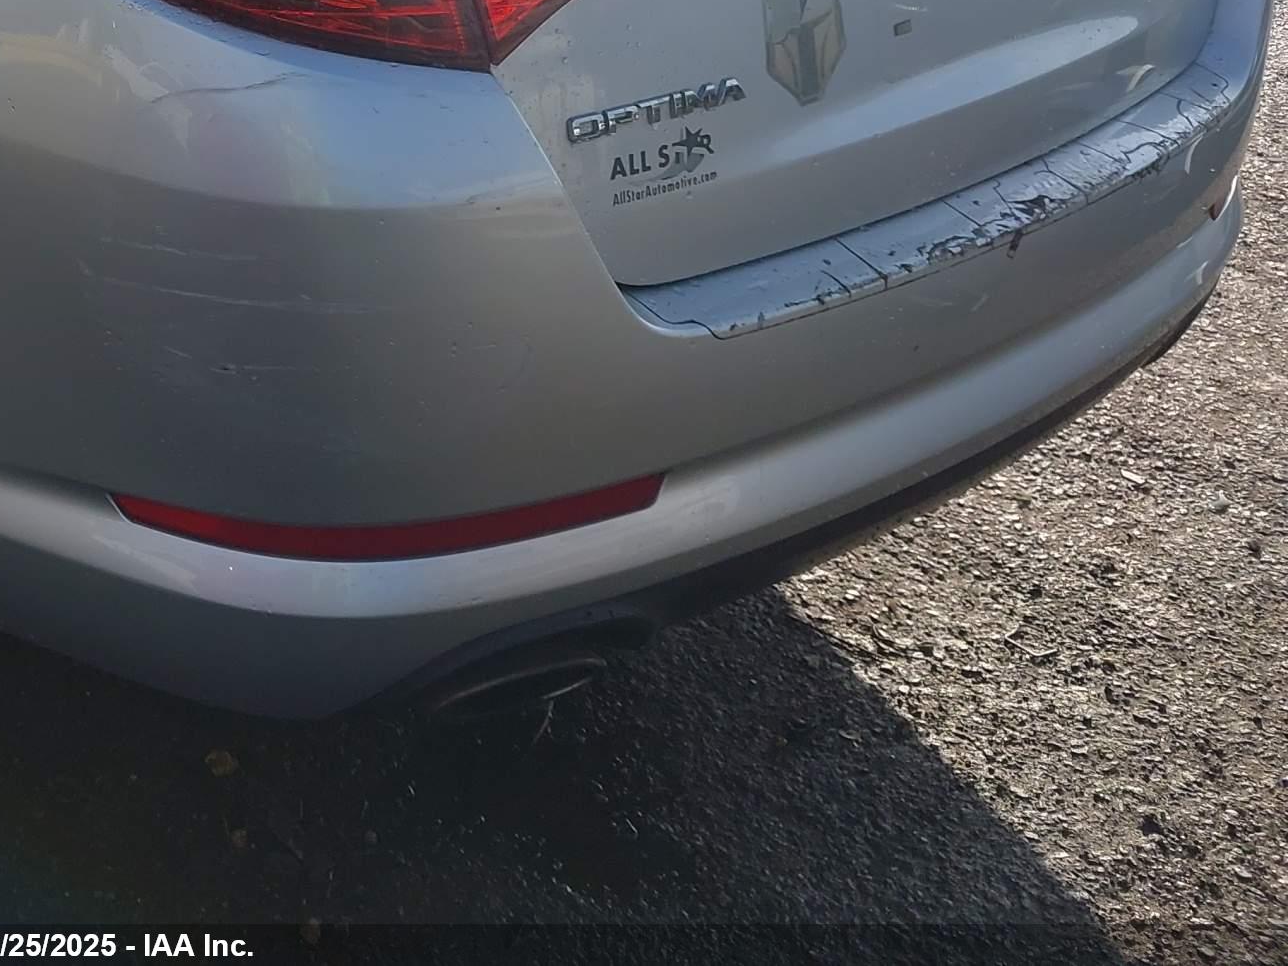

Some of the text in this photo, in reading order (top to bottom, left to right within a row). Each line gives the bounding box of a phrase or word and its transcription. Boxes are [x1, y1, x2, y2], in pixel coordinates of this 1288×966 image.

[566, 76, 747, 144] OPTIMA
[610, 150, 651, 181] ALL
[613, 171, 718, 207] AllStarAutomotive.com
